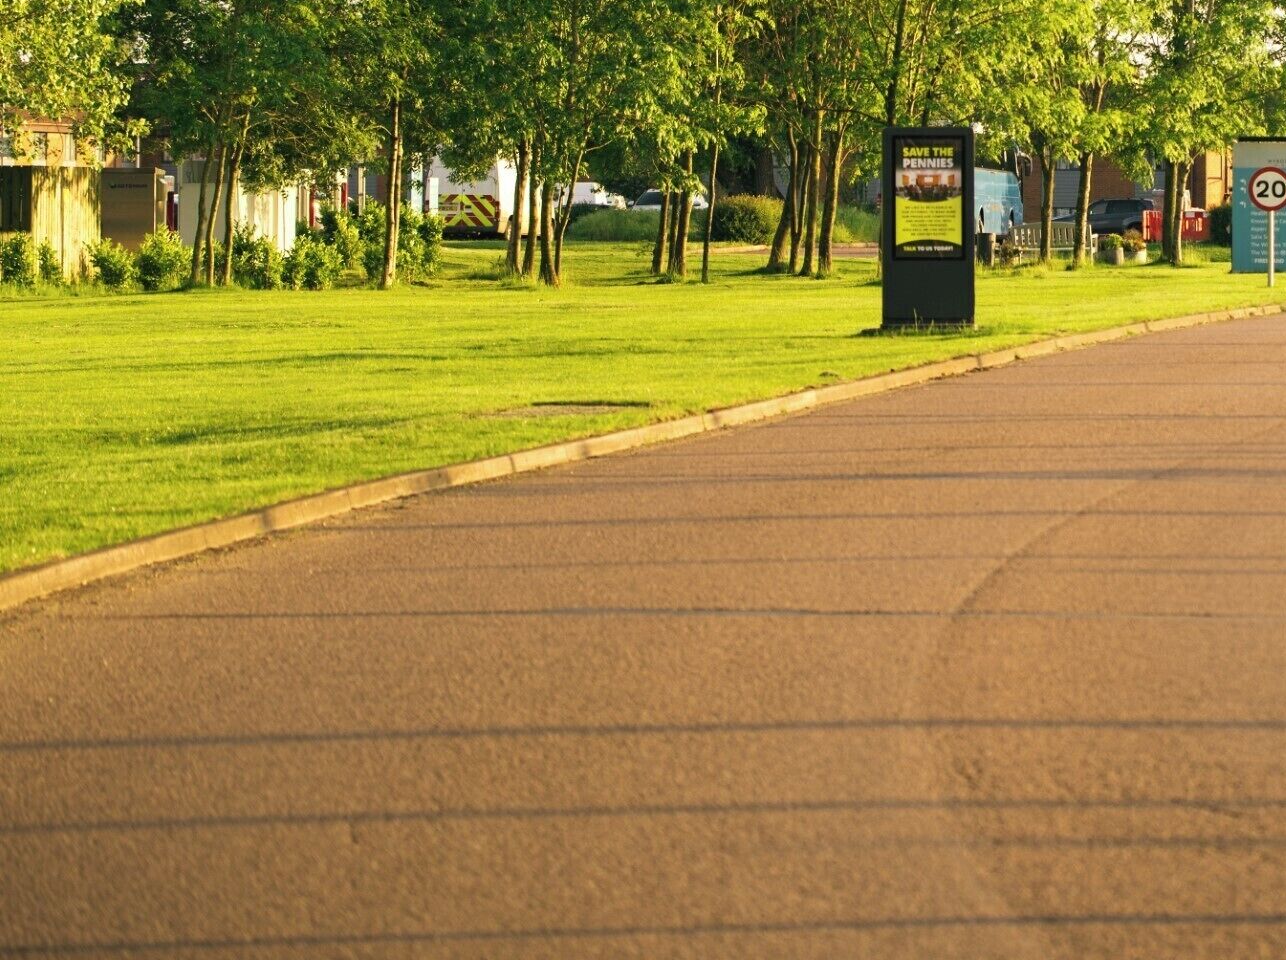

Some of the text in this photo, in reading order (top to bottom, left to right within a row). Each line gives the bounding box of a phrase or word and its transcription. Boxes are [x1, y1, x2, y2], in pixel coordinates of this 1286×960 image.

[902, 147, 954, 157] SAVE THE
[902, 158, 954, 168] PENNIES
[1256, 180, 1286, 198] 20
